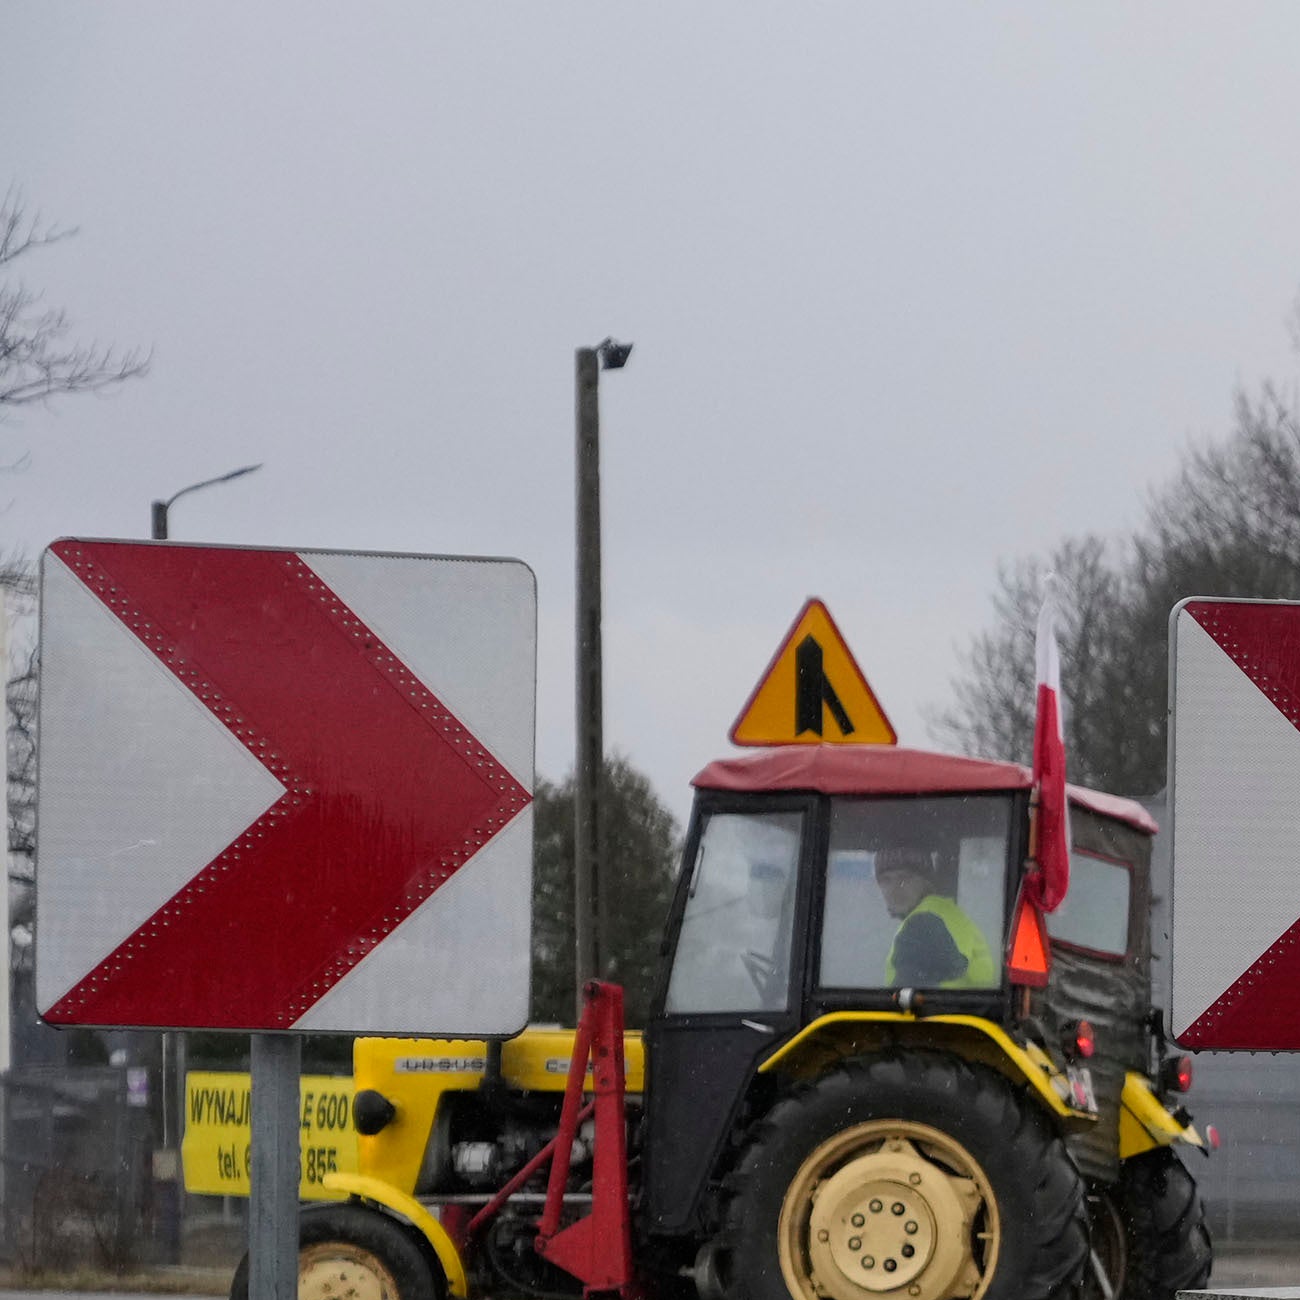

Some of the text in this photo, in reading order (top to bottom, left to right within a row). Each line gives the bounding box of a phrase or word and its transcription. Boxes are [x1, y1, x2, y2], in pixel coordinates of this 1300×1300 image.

[403, 1058, 485, 1072] URSUS
[316, 1093, 348, 1129] 600
[218, 1143, 241, 1180] tel.
